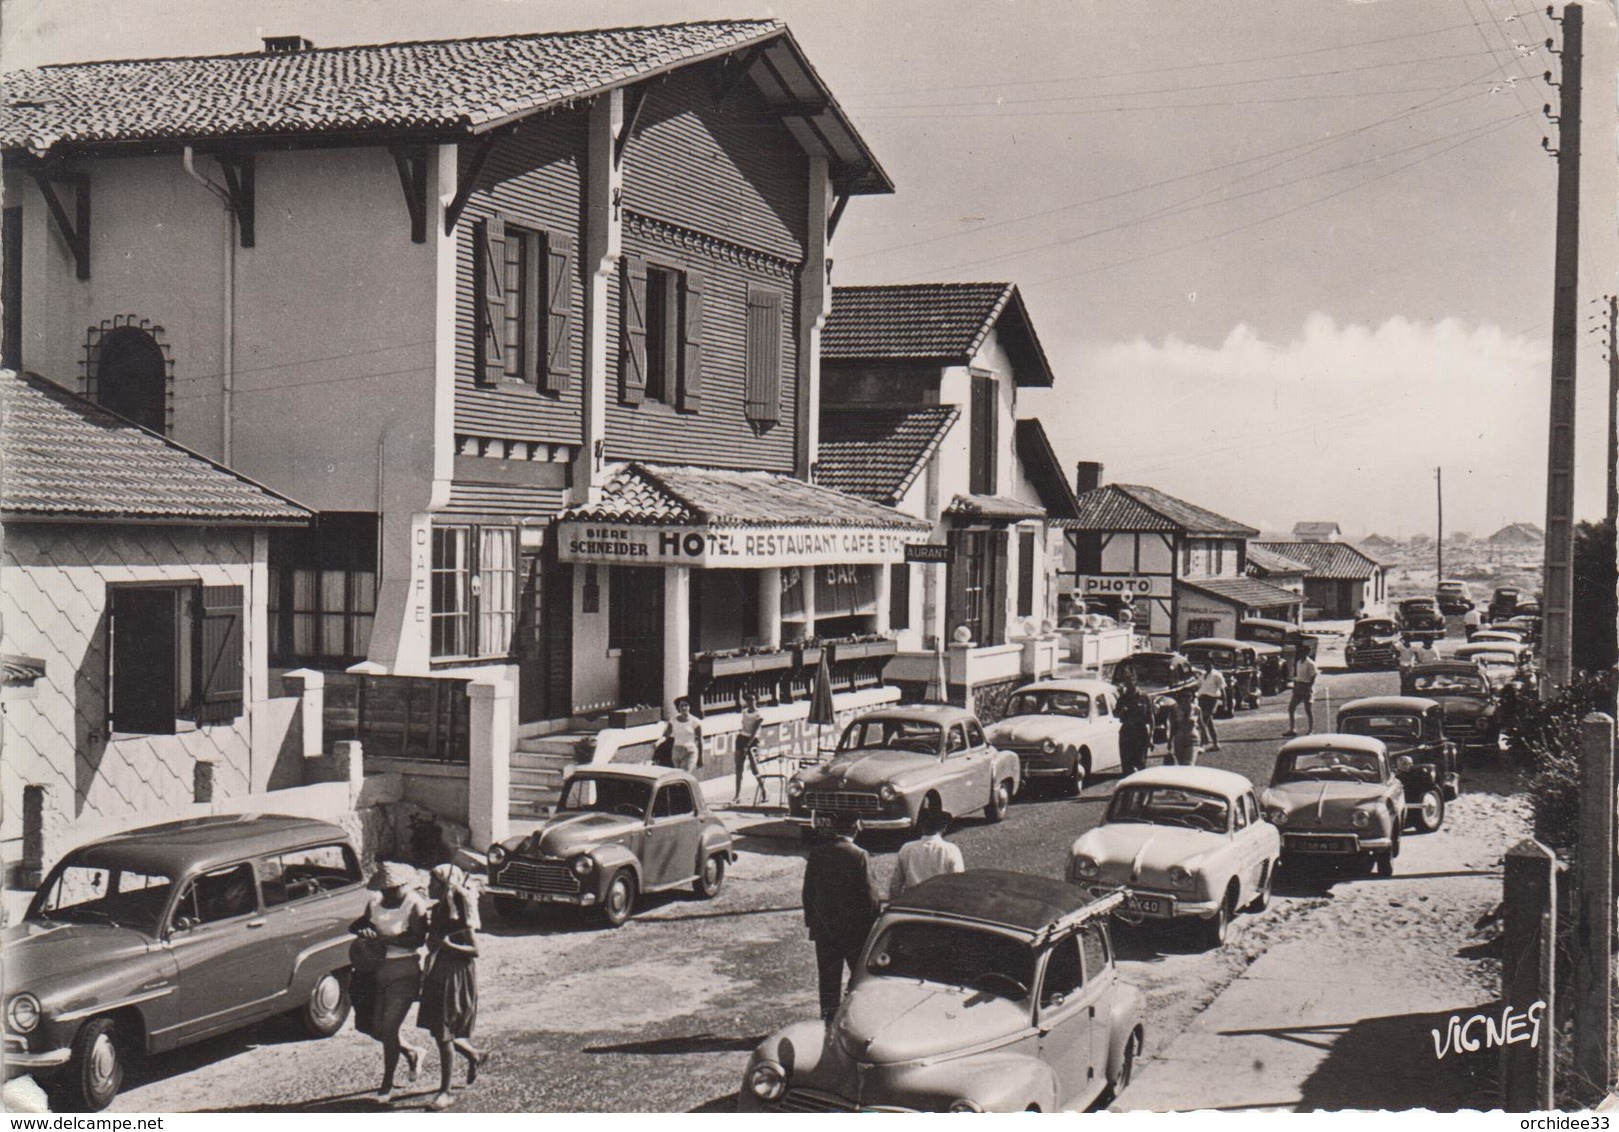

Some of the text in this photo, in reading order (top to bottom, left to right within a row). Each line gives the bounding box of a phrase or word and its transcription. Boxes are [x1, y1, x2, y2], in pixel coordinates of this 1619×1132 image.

[570, 541, 649, 557] SCHNEIDER
[659, 532, 739, 557] HOTEL
[746, 534, 837, 556] RESTAURANT
[827, 563, 858, 584] BAR
[1087, 580, 1149, 592] PHOTO
